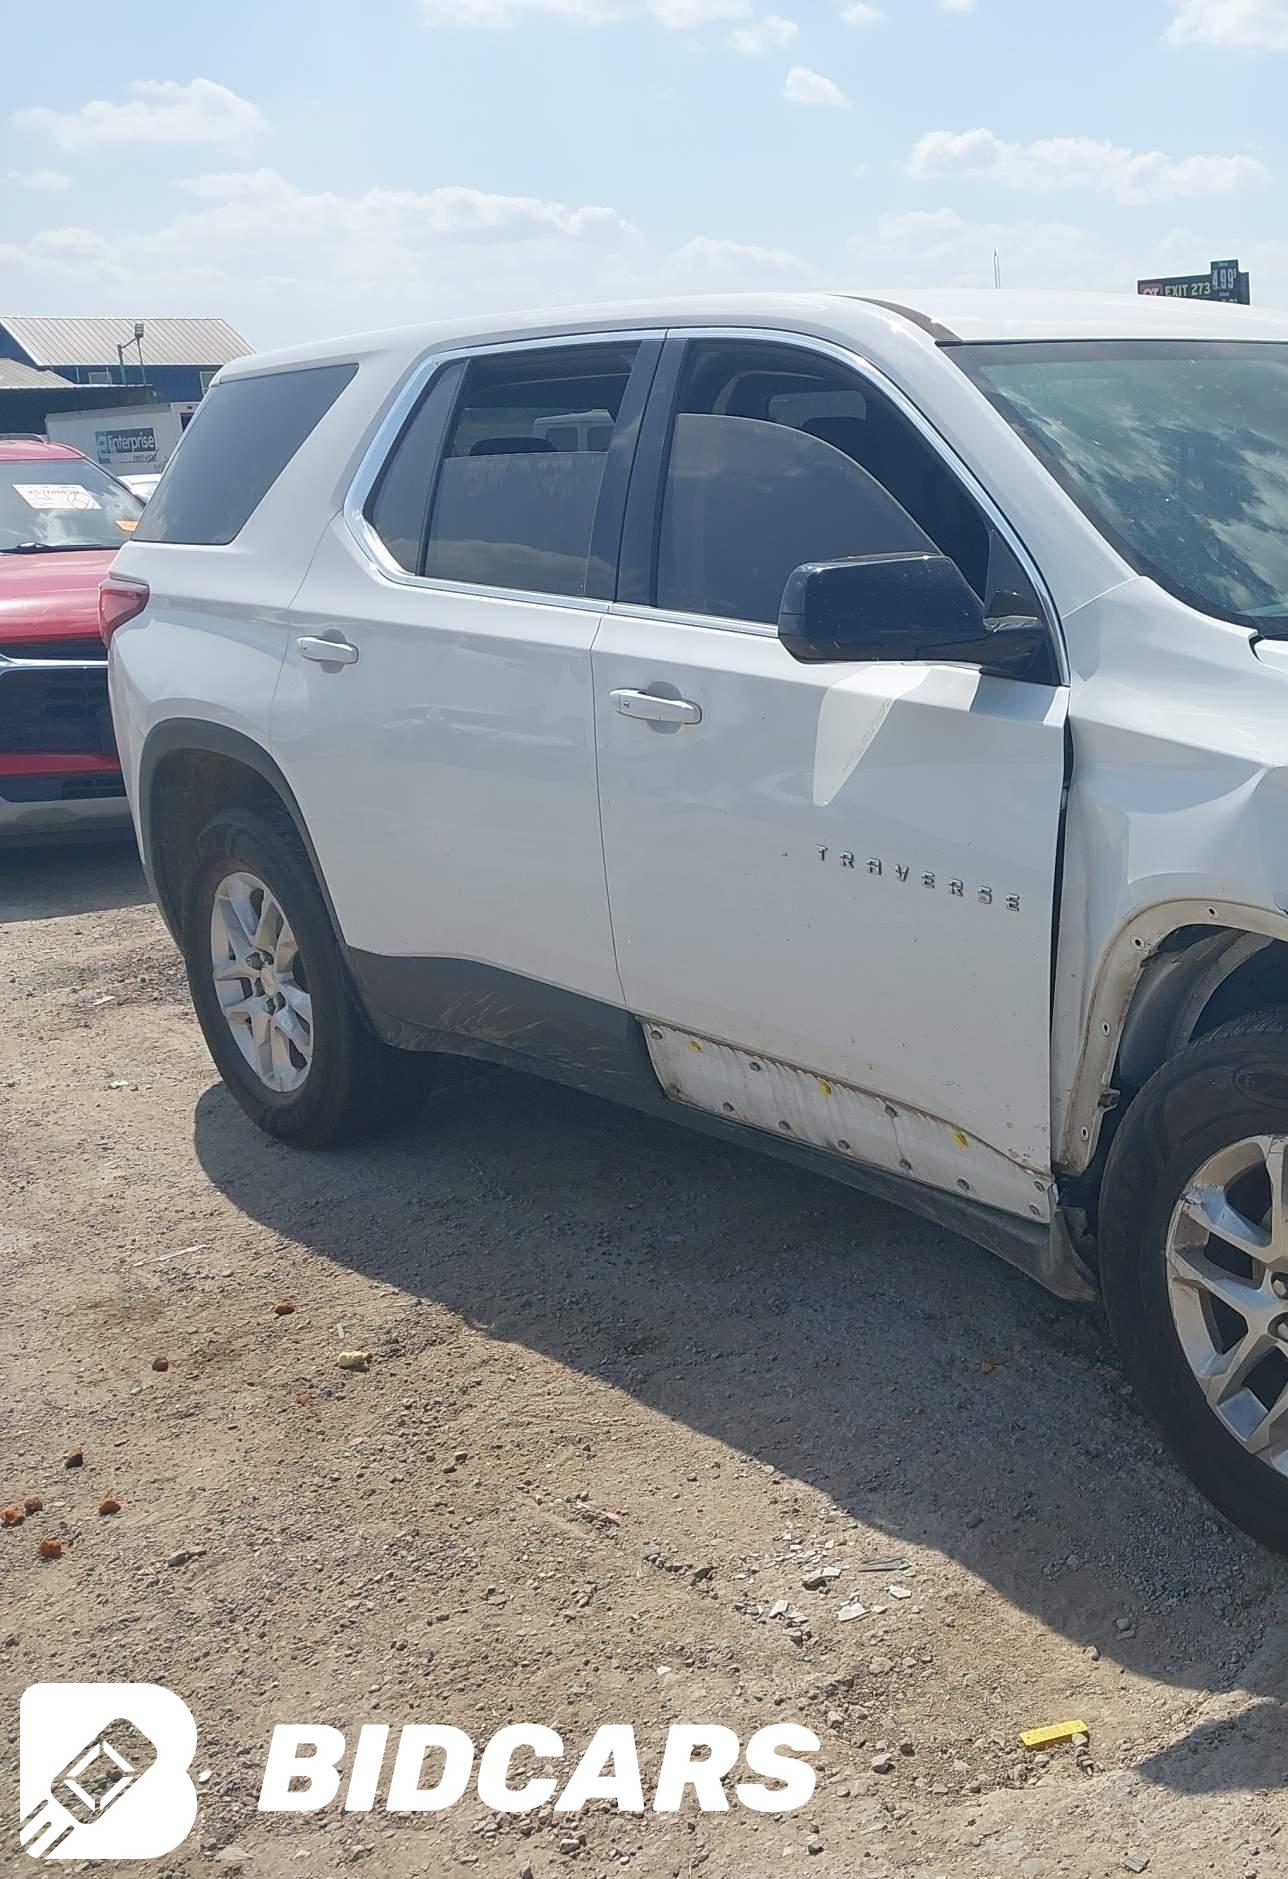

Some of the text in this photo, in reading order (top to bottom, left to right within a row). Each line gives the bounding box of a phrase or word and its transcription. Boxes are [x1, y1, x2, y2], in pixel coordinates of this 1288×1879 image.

[1165, 284, 1188, 297] EXIT
[1191, 282, 1210, 296] 273
[107, 431, 155, 453] Enterprise
[815, 843, 1020, 912] TRAVERSE
